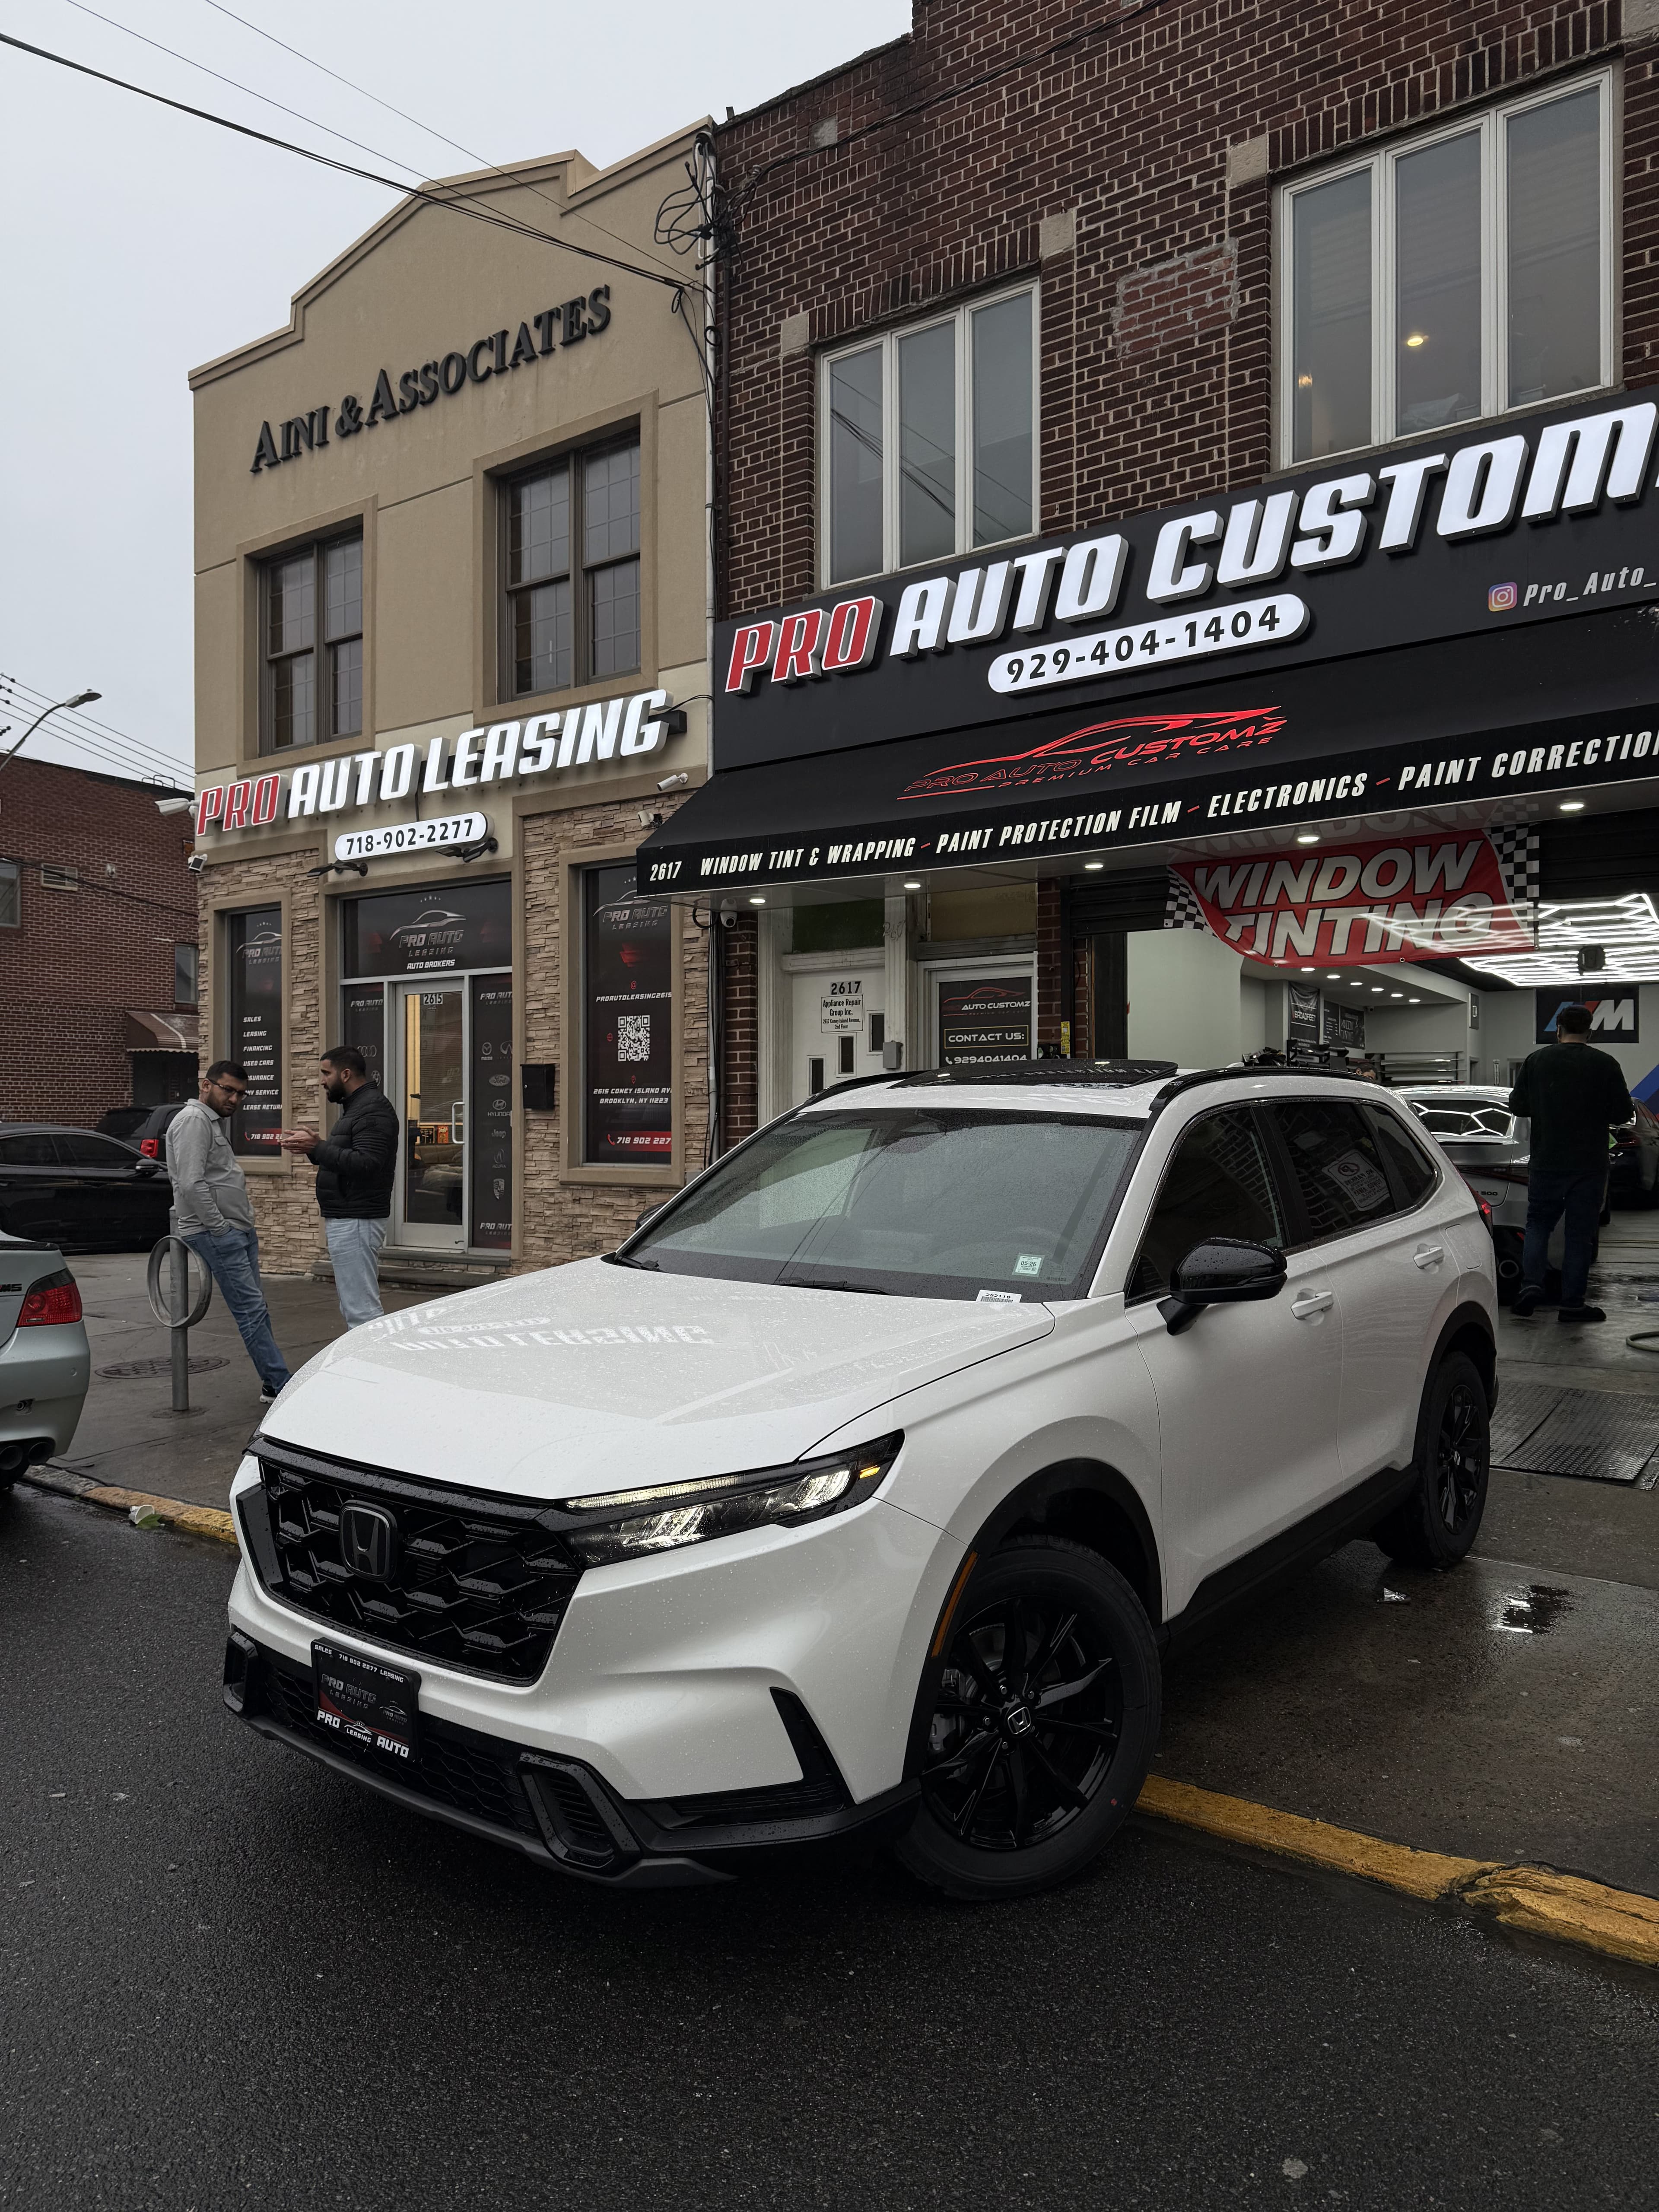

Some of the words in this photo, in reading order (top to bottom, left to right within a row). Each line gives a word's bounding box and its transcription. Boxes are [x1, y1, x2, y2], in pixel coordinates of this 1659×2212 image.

[249, 405, 330, 473] AINI
[335, 394, 364, 438] &
[364, 284, 611, 426] ASSOCIATES
[725, 595, 882, 695] PRO
[890, 533, 1128, 660] AUTO
[1146, 402, 1659, 604] CUSTOM
[1006, 604, 1281, 684] 929-404-1404
[196, 772, 289, 836] PRO
[288, 742, 423, 818] AUTO
[422, 689, 674, 794] LEASING
[903, 771, 976, 792] PRO
[980, 759, 1083, 784] AUTO
[1090, 716, 1288, 766] CUSTOMZ
[997, 763, 1112, 789] PREMIUM
[1127, 752, 1181, 766] CAR
[1197, 736, 1275, 755] CARE
[649, 861, 682, 882] 2617
[700, 852, 763, 876] WINDOW
[768, 848, 804, 870] TINT
[809, 847, 820, 866] &
[827, 837, 917, 864] WRAPPING
[935, 828, 995, 854] PAINT
[998, 810, 1122, 846] PROTECTION
[1128, 800, 1182, 829] FILM
[1207, 772, 1369, 818] ELECTRONICS
[1398, 756, 1483, 791] PAINT
[346, 818, 474, 856] 718-902-2277
[1194, 839, 1484, 909] WINDOW
[602, 909, 630, 923] PRO
[632, 905, 668, 920] AUTO
[612, 920, 658, 930] LEASING
[1224, 891, 1494, 959] TINTING
[399, 933, 426, 948] PRO
[428, 930, 464, 945] AUTO
[242, 948, 261, 959] PRO
[262, 946, 282, 956] AUT
[408, 947, 454, 957] LEASING
[407, 961, 423, 970] AUTO
[424, 959, 455, 968] BROKERS
[596, 992, 672, 1002] PROAUTOLEASING2615
[831, 981, 861, 995] 2617
[424, 994, 442, 1004] 2615
[823, 999, 844, 1009] Appliance
[845, 998, 861, 1007] Repair
[987, 1001, 1031, 1009] CUSTOMZ
[830, 1008, 843, 1017] Group
[948, 1033, 1002, 1042] CONTACT
[1005, 1032, 1025, 1040] US:
[953, 1054, 1028, 1065] 9294041404
[314, 1644, 332, 1655] SALES
[339, 1654, 348, 1662] 718
[362, 1662, 377, 1672] 2277
[380, 1669, 404, 1683] LEASING
[321, 1674, 344, 1691] PRO
[346, 1684, 377, 1704] AUTO
[330, 1689, 369, 1710] LEASING
[317, 1710, 341, 1729] PRO
[376, 1735, 410, 1758] AUTO
[346, 1728, 372, 1743] LEASING
